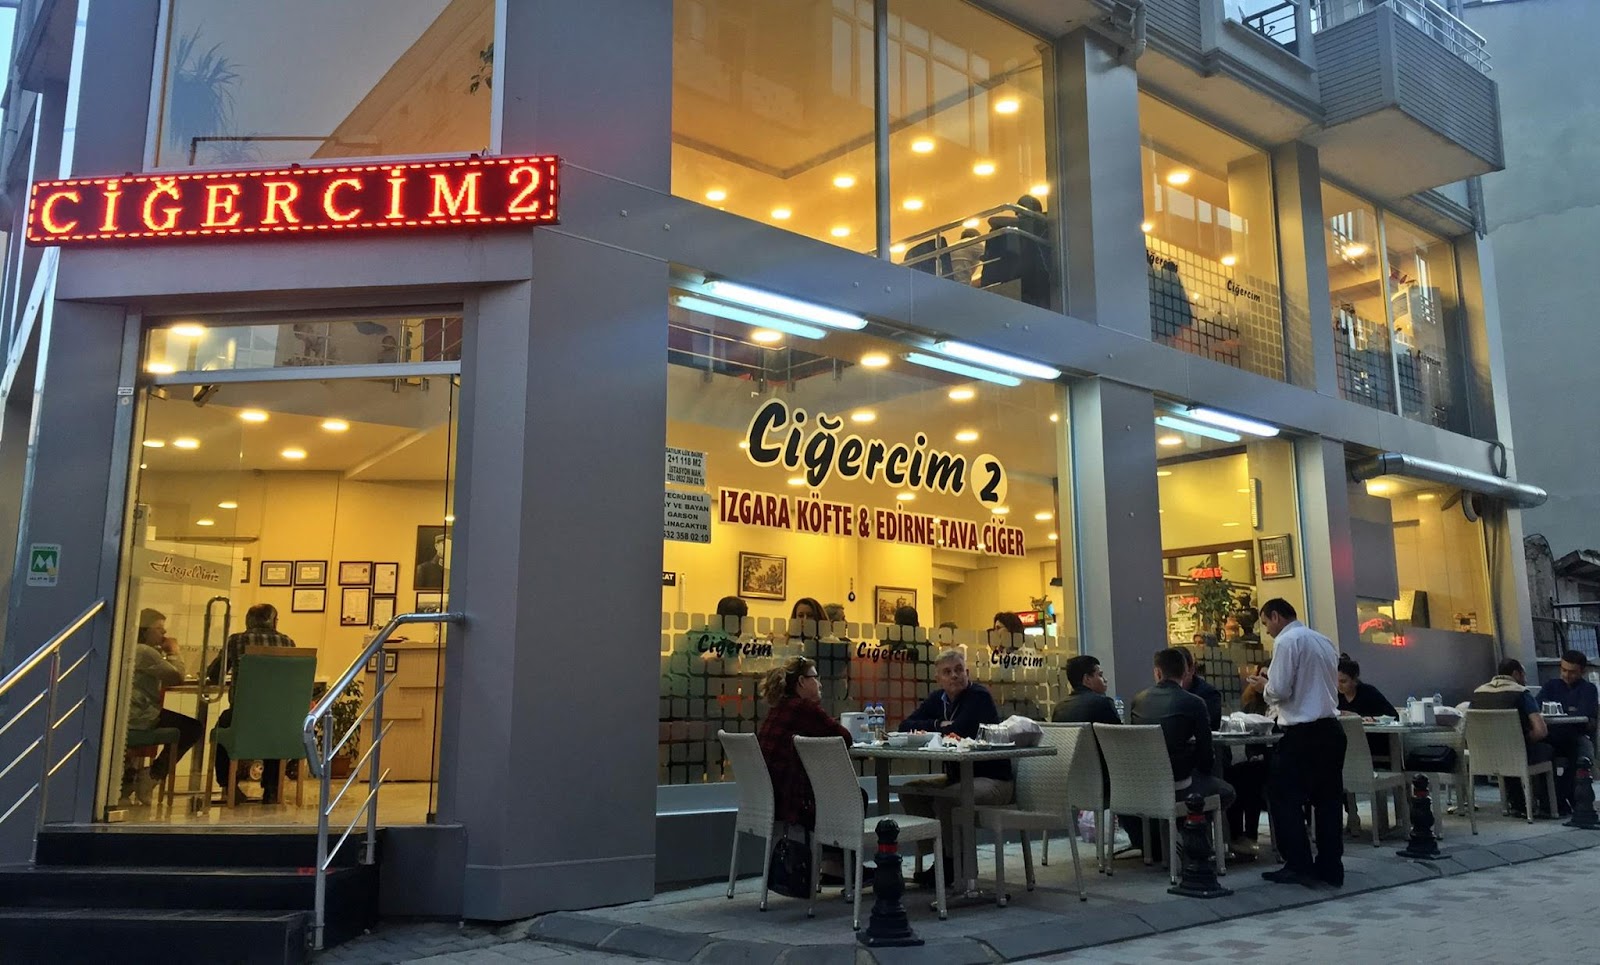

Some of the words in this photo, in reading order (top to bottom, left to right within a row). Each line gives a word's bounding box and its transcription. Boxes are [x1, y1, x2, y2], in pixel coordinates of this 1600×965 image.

[41, 168, 482, 233] CİĞERCİM
[508, 166, 540, 214] 2
[1227, 280, 1261, 302] Ciğercim
[668, 454, 679, 463] 2+1
[749, 402, 966, 493] Ciğercim
[979, 461, 1001, 502] 2
[668, 511, 698, 520] GARSON
[685, 504, 709, 512] BAYAN
[720, 490, 790, 528] IZGARA
[797, 492, 852, 536] KÖFTE
[859, 508, 870, 538] &
[876, 504, 935, 546] EDİRNE
[940, 519, 978, 550] TAVA
[983, 518, 1025, 556] CİĞER
[676, 532, 688, 540] 358
[690, 533, 699, 541] 02
[698, 634, 772, 658] Ciğercim
[991, 649, 1043, 668] Ciğercim
